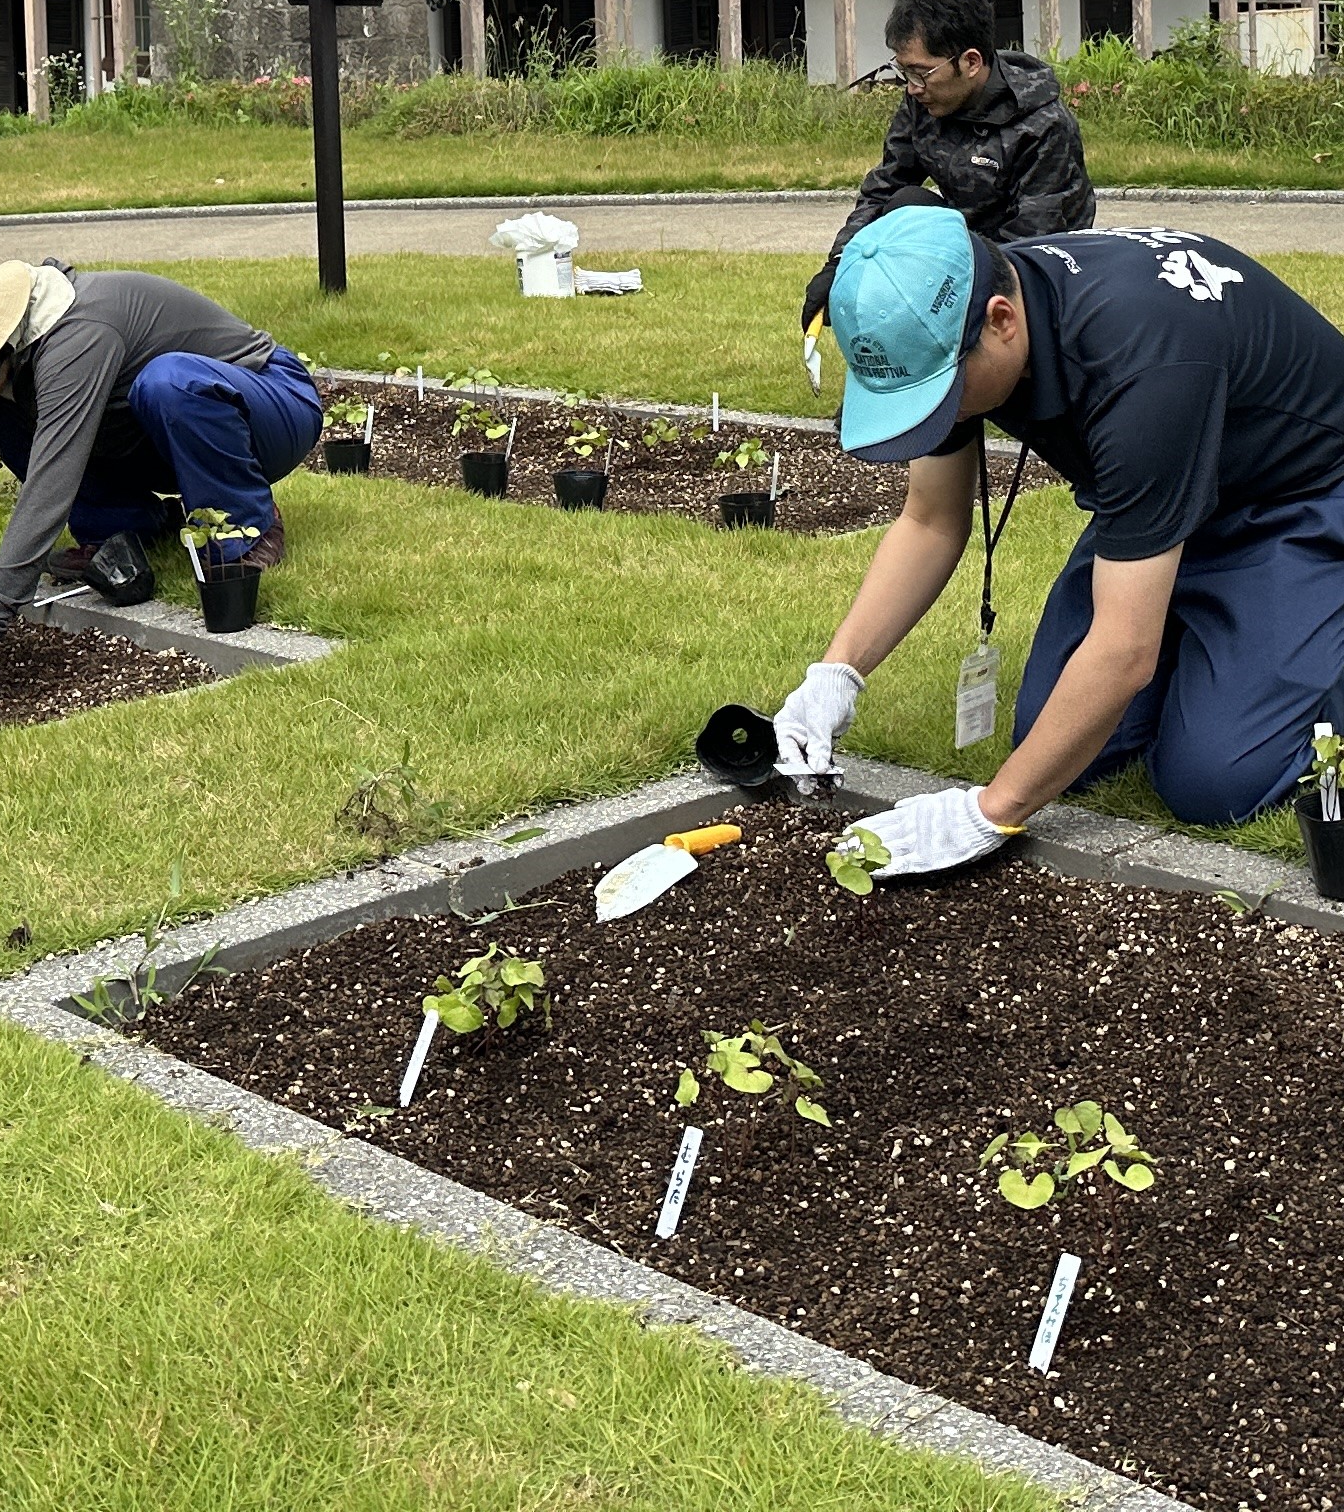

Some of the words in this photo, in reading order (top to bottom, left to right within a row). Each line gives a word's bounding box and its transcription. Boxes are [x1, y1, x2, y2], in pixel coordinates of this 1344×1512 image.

[944, 290, 958, 308] CITY
[669, 1142, 692, 1204] むらた
